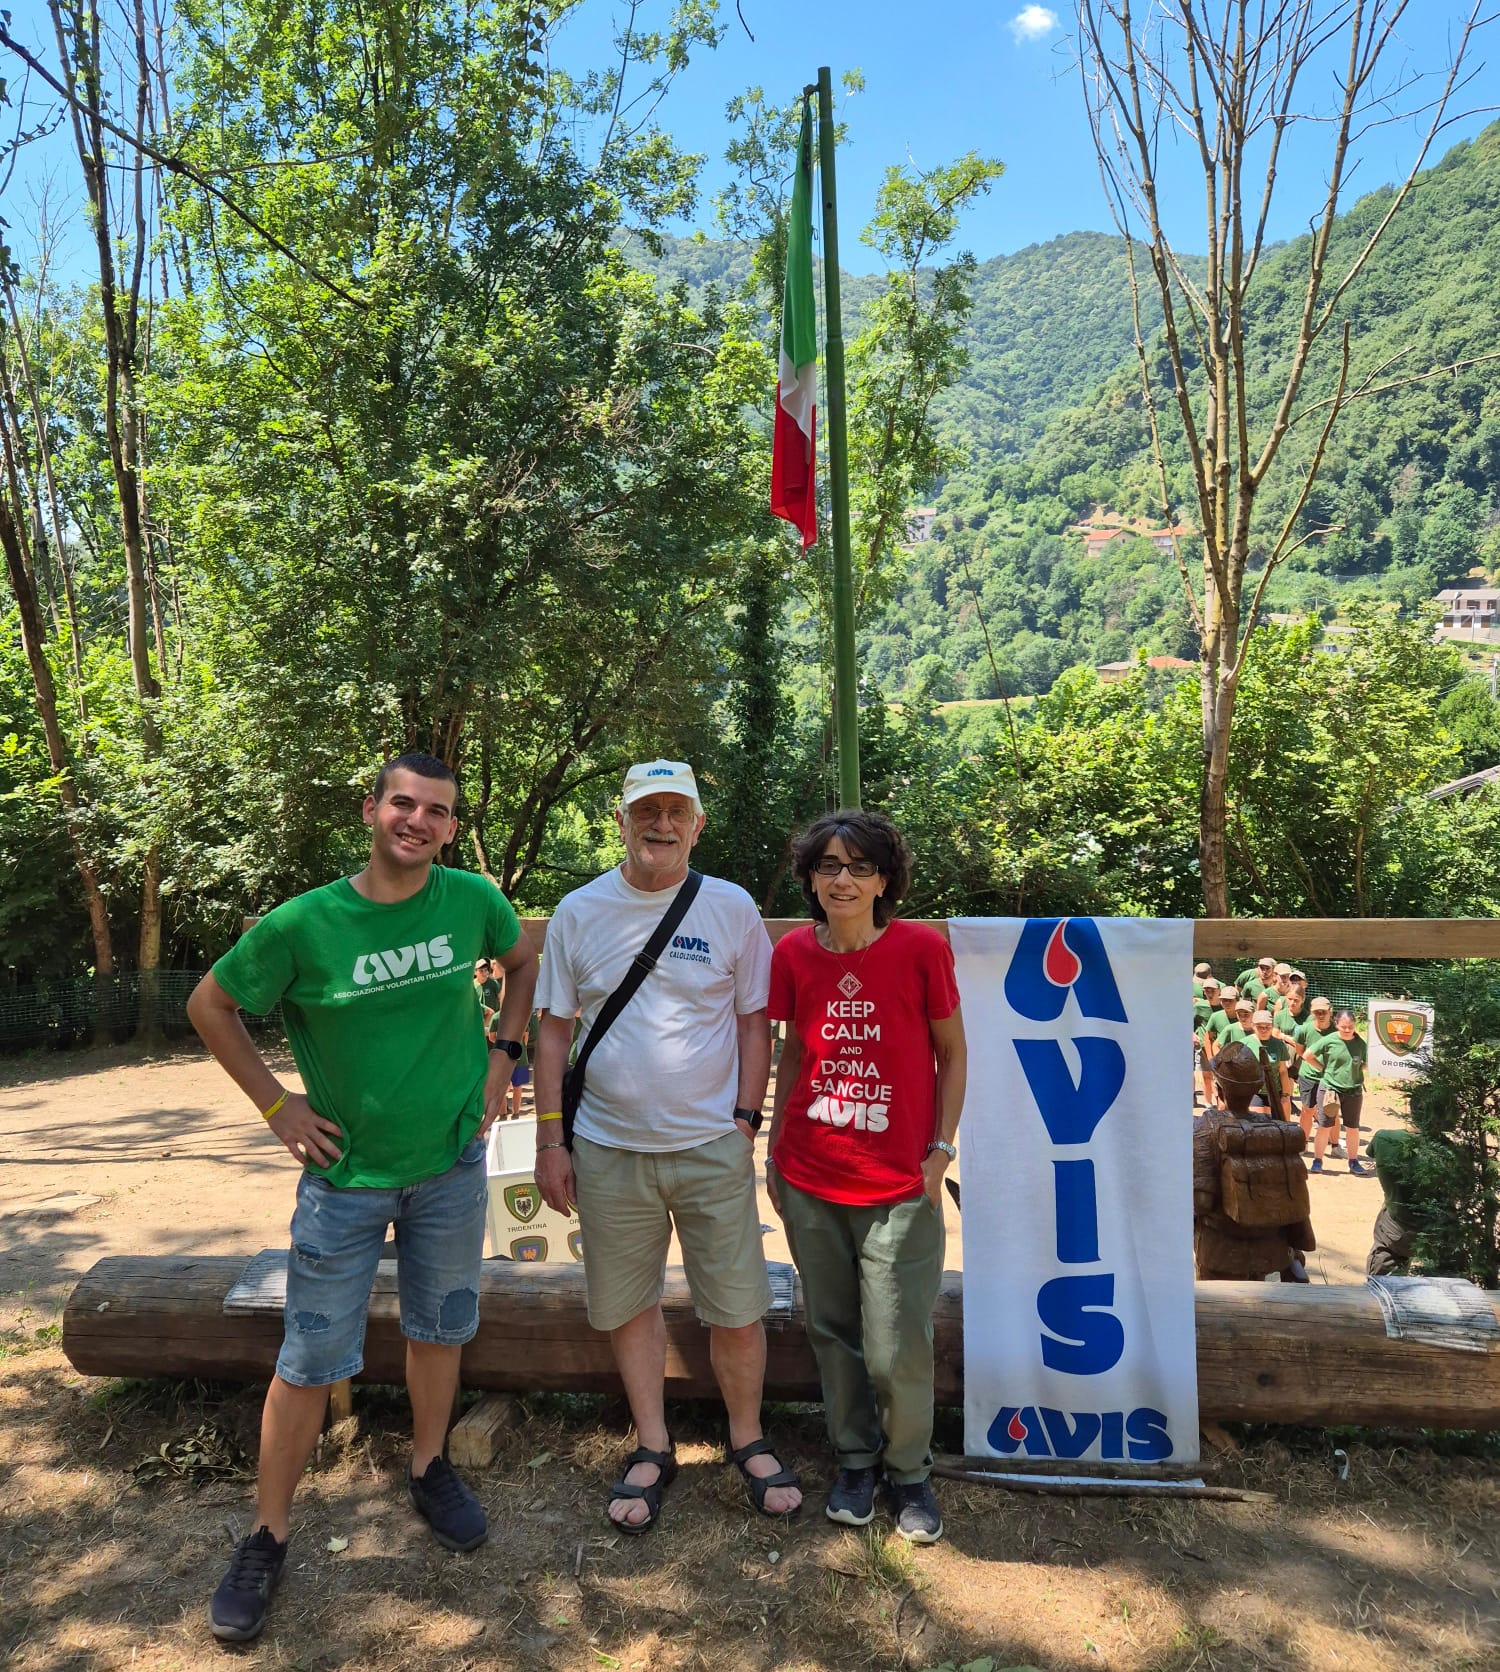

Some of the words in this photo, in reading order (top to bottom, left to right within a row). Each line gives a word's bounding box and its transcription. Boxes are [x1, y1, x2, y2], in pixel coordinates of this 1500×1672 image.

[647, 768, 674, 777] AVIS
[672, 935, 710, 954] AVIS
[352, 934, 454, 985] AVIS
[333, 985, 385, 999] ASSOCIAZIONE
[386, 976, 425, 990] VOLONTARI
[426, 969, 452, 981] ITALIANI
[826, 1001, 875, 1018] KEEP
[820, 1023, 881, 1041] CALM
[839, 1046, 863, 1055] AND
[820, 1060, 880, 1079] DONA
[810, 1078, 893, 1102] SANGUE
[806, 1094, 890, 1133] AVIS
[1004, 918, 1129, 1377] AVIS
[507, 1223, 548, 1233] TRIDENTINA
[986, 1405, 1174, 1462] AVIS
